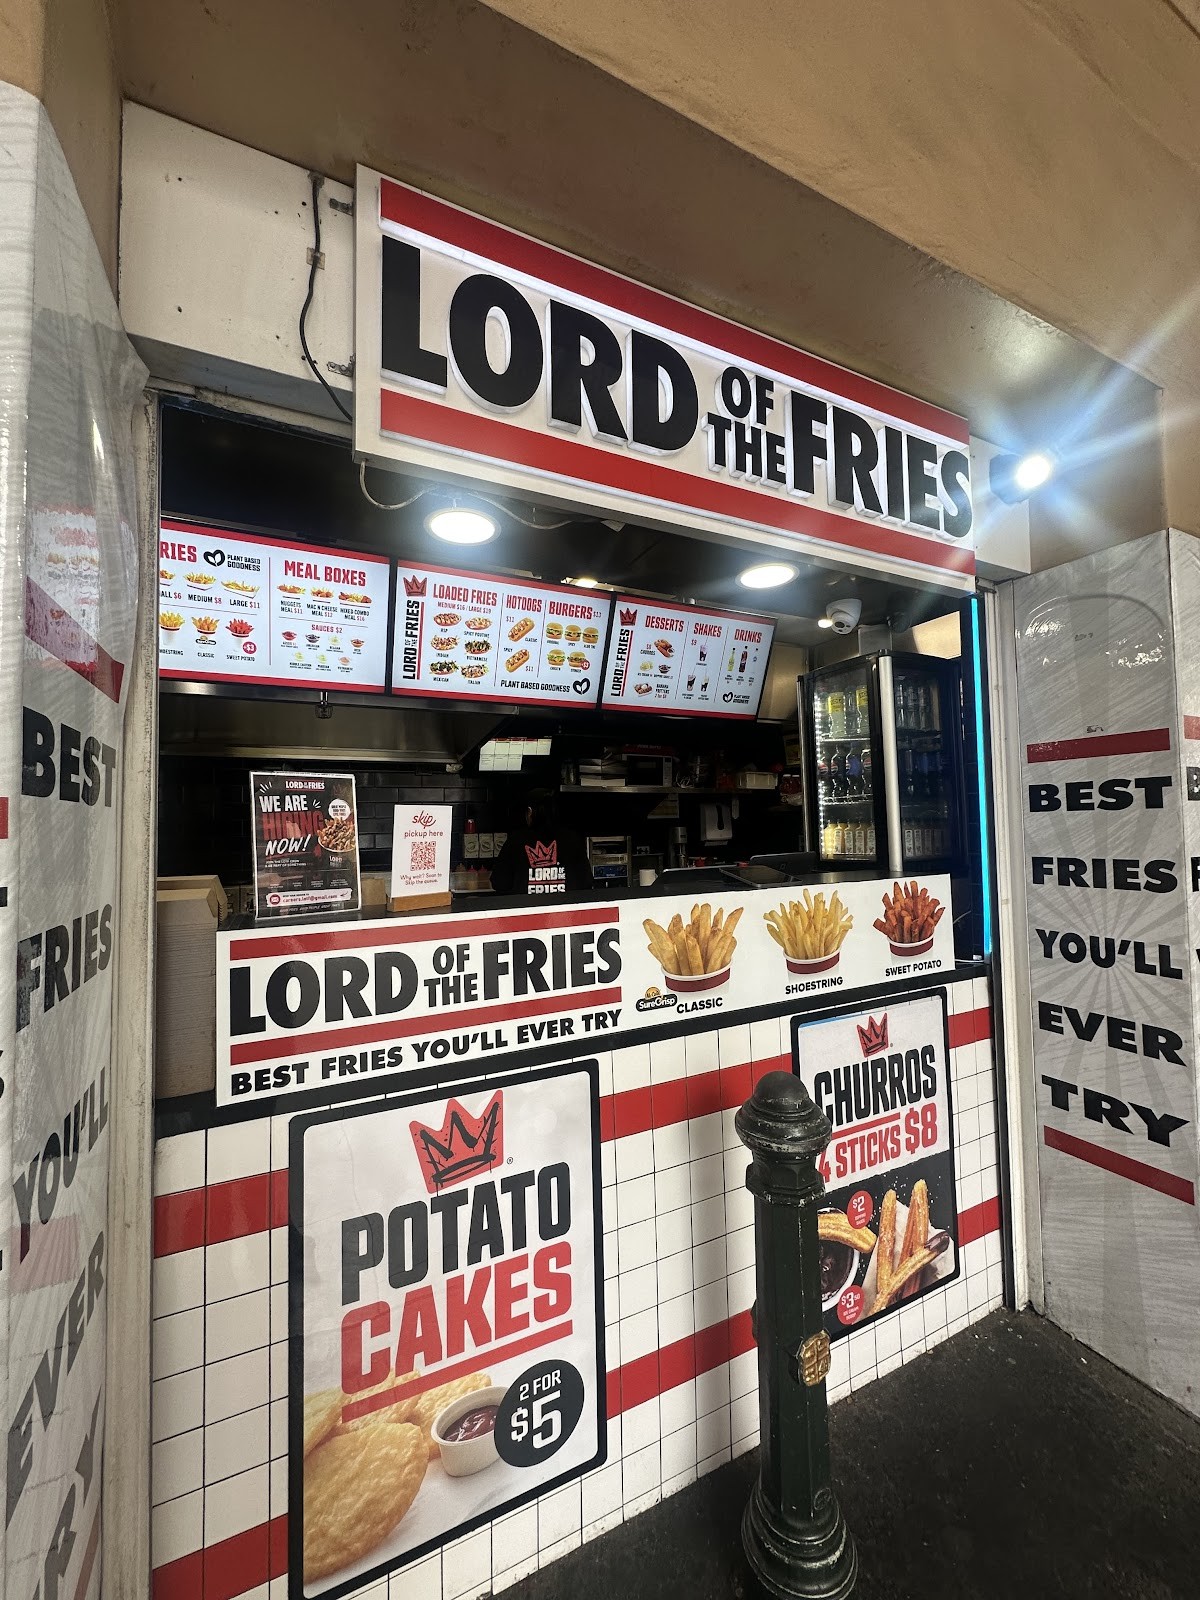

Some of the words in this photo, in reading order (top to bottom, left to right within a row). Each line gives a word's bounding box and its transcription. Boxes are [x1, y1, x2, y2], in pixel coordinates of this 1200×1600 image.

[381, 233, 700, 456] LORD
[717, 365, 774, 427] OF
[702, 411, 785, 487] THE
[785, 389, 974, 540] FRIES
[227, 554, 244, 562] PLANT
[244, 556, 261, 565] BASED
[227, 561, 261, 572] GOODNESS
[284, 559, 320, 581] MEAL
[324, 565, 366, 587] BOXES
[173, 591, 182, 600] $6
[188, 593, 213, 603] MEDIUM
[229, 599, 248, 607] LARGE
[249, 601, 261, 609] $11
[433, 583, 469, 604] LOADED
[471, 589, 498, 607] FRIES
[437, 601, 456, 610] MEDIUM
[468, 605, 482, 613] LARGE
[506, 594, 543, 613] HOTDOGS
[404, 599, 420, 638] FRIES
[549, 601, 593, 620] BURGERS
[645, 615, 685, 633] DESSERTS
[311, 624, 334, 633] SAUCES
[693, 622, 723, 638] SHAKES
[734, 628, 763, 643] DRINKS
[616, 628, 630, 662] FRIES
[402, 647, 417, 680] LORD
[500, 679, 520, 689] PLANT
[520, 681, 540, 691] BASED
[540, 683, 571, 693] GOODNESS
[611, 668, 624, 697] LORD
[21, 705, 117, 808] BEST
[285, 780, 304, 790] LORD
[308, 781, 325, 790] FRIES
[1027, 775, 1173, 813] BEST
[259, 795, 281, 813] WE
[285, 795, 308, 811] ARE
[262, 810, 325, 841] HIRING
[404, 829, 428, 839] pickup
[428, 829, 444, 837] here
[412, 810, 437, 829] skip
[265, 833, 311, 857] NOW!
[528, 867, 558, 881] LORD
[1031, 855, 1179, 894] FRIES
[16, 903, 113, 1033] FRIES
[423, 971, 478, 1008] THE
[482, 927, 622, 1000] FRIES
[432, 943, 470, 975] OF
[885, 963, 911, 977] SWEET
[912, 958, 942, 973] POTATO
[1035, 928, 1184, 981] YOU'LL
[229, 951, 419, 1037] LORD
[785, 976, 844, 996] SHOESTRING
[638, 995, 676, 1010] SureCrisp
[676, 997, 723, 1014] CLASSIC
[1038, 1000, 1187, 1067] EVER
[231, 1062, 310, 1096] BEST
[321, 1045, 403, 1080] FRIES
[410, 1028, 508, 1063] YOU'LL
[517, 1014, 575, 1045] EVER
[581, 1008, 622, 1032] TRY
[813, 1044, 937, 1128] CHURROS
[1041, 1075, 1192, 1148] TRY
[836, 1124, 901, 1179] STICKS
[904, 1102, 938, 1156] $8
[13, 1065, 109, 1265] YOU'LL
[852, 1195, 865, 1212] $2
[341, 1161, 572, 1306] POTATO
[341, 1240, 573, 1396] CAKES
[5, 1229, 105, 1533] EVER
[519, 1383, 530, 1401] 2
[532, 1368, 562, 1396] FOR
[510, 1390, 562, 1450] $5
[32, 1383, 102, 1600] RY
